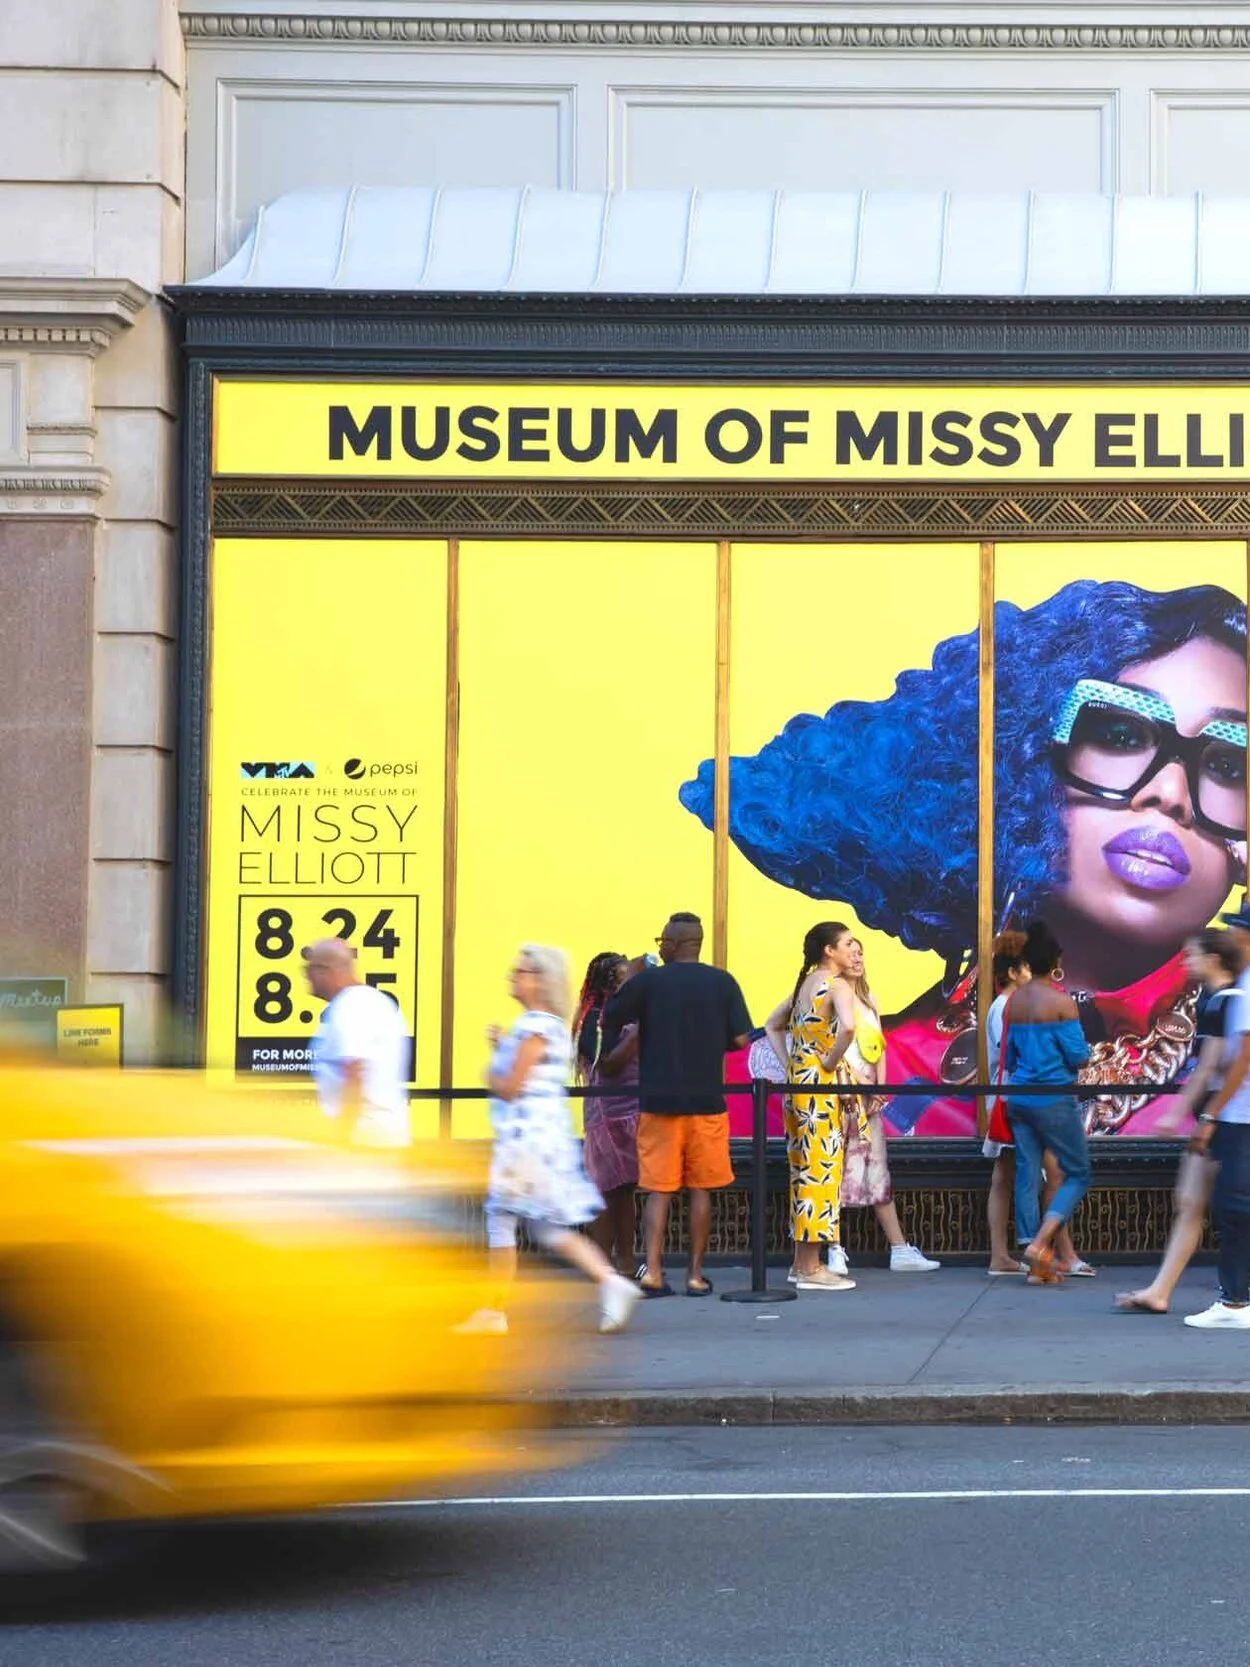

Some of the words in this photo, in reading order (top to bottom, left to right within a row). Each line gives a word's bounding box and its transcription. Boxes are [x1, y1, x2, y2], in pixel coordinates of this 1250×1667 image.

[328, 404, 678, 463] MUSEUM
[704, 408, 809, 464] OF
[835, 410, 1072, 468] MISSY
[369, 760, 418, 778] pepsi
[241, 788, 310, 796] CELEBRATE
[317, 788, 337, 796] THE
[344, 788, 397, 796] MUSEUM
[402, 788, 417, 796] OF
[240, 804, 418, 842] MISSY
[238, 852, 417, 884] ELLIOTT
[78, 1038, 99, 1047] HERE
[253, 1049, 280, 1060] FOR
